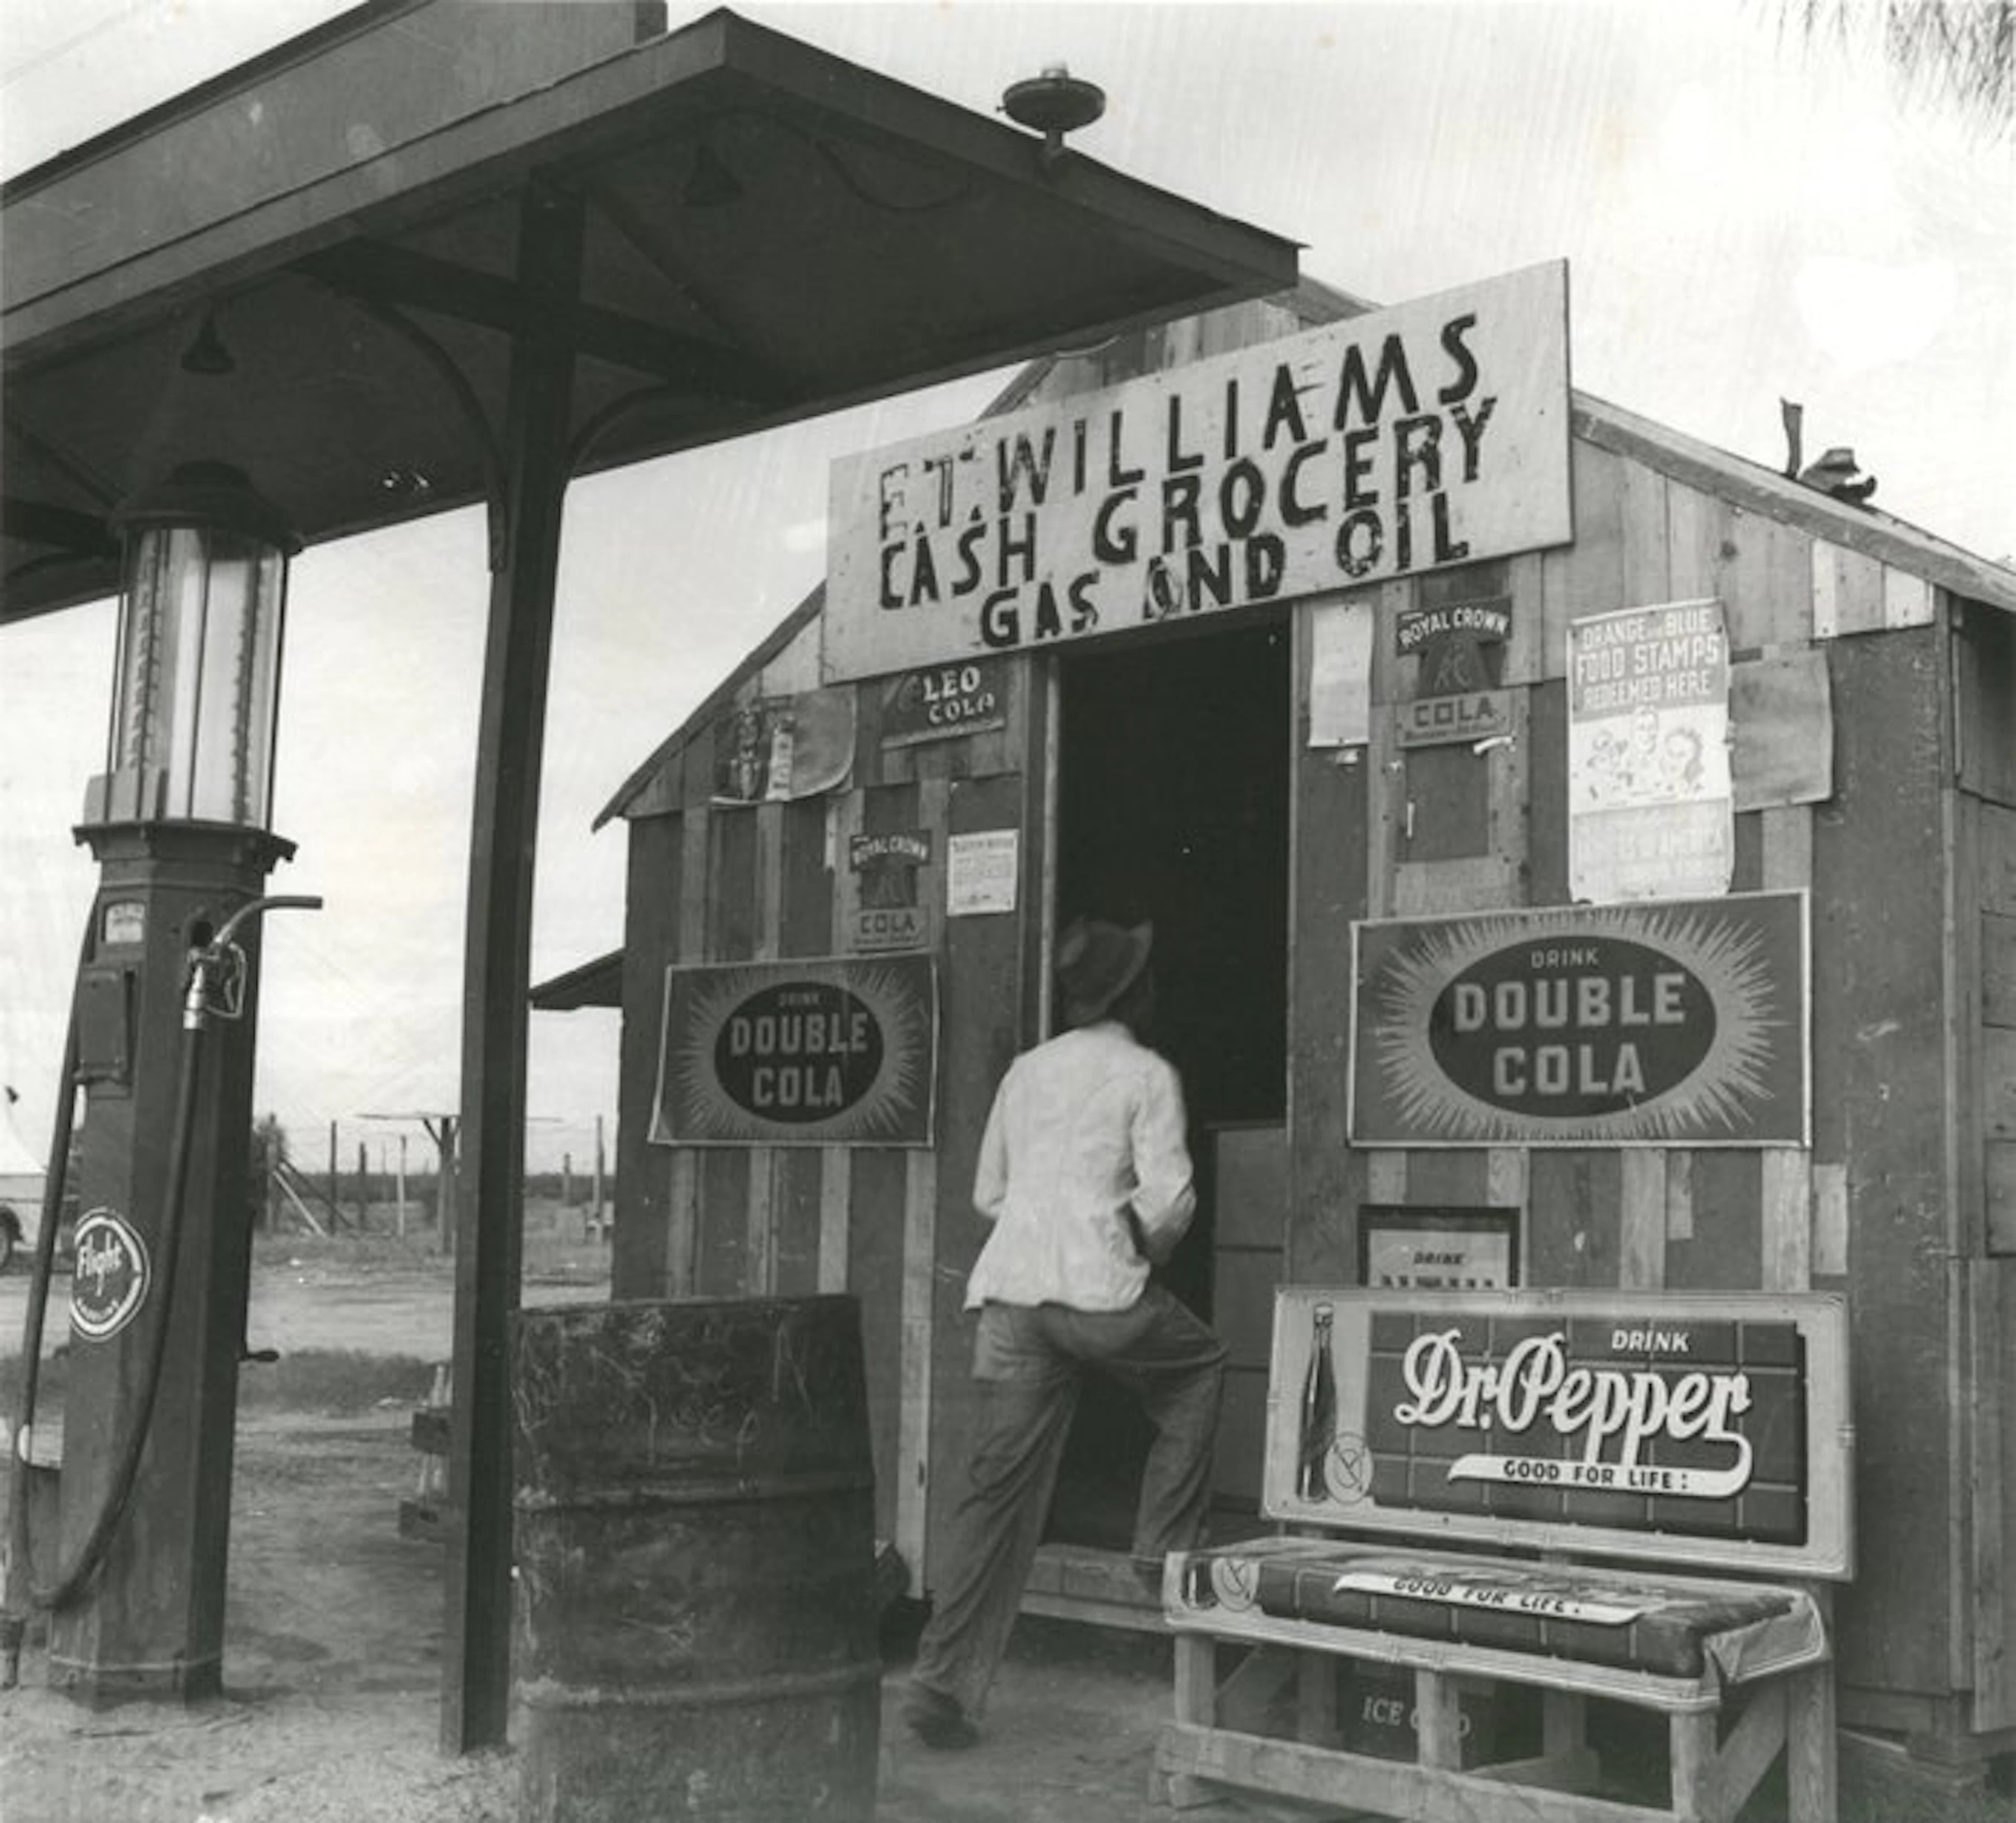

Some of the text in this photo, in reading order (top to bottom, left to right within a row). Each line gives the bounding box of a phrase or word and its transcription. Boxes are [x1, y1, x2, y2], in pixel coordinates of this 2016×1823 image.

[996, 313, 1478, 514] WILLIAMS
[879, 396, 1497, 610] CASH GROCERY
[980, 491, 1469, 648] GAS AND OIL
[1399, 606, 1510, 648] ROYAL CROWN
[1665, 606, 1713, 637] BLUE
[1577, 634, 1720, 686] FOOD STAMPS
[1666, 669, 1714, 700] HERE
[928, 692, 995, 725] COLA
[1414, 696, 1495, 727] COLA
[860, 914, 916, 934] COLA
[1531, 947, 1600, 969] DRINK
[1454, 972, 1687, 1032] DOUBLE
[731, 1012, 868, 1056] DOUBLE
[753, 1065, 843, 1107] COLA
[1494, 1043, 1645, 1095] COLA
[1611, 1329, 1689, 1353] DRINK
[1497, 1332, 1752, 1466] Pepper
[1504, 1459, 1560, 1480] GOOD
[1574, 1465, 1614, 1484] FOR
[1361, 1694, 1404, 1727] ICE
